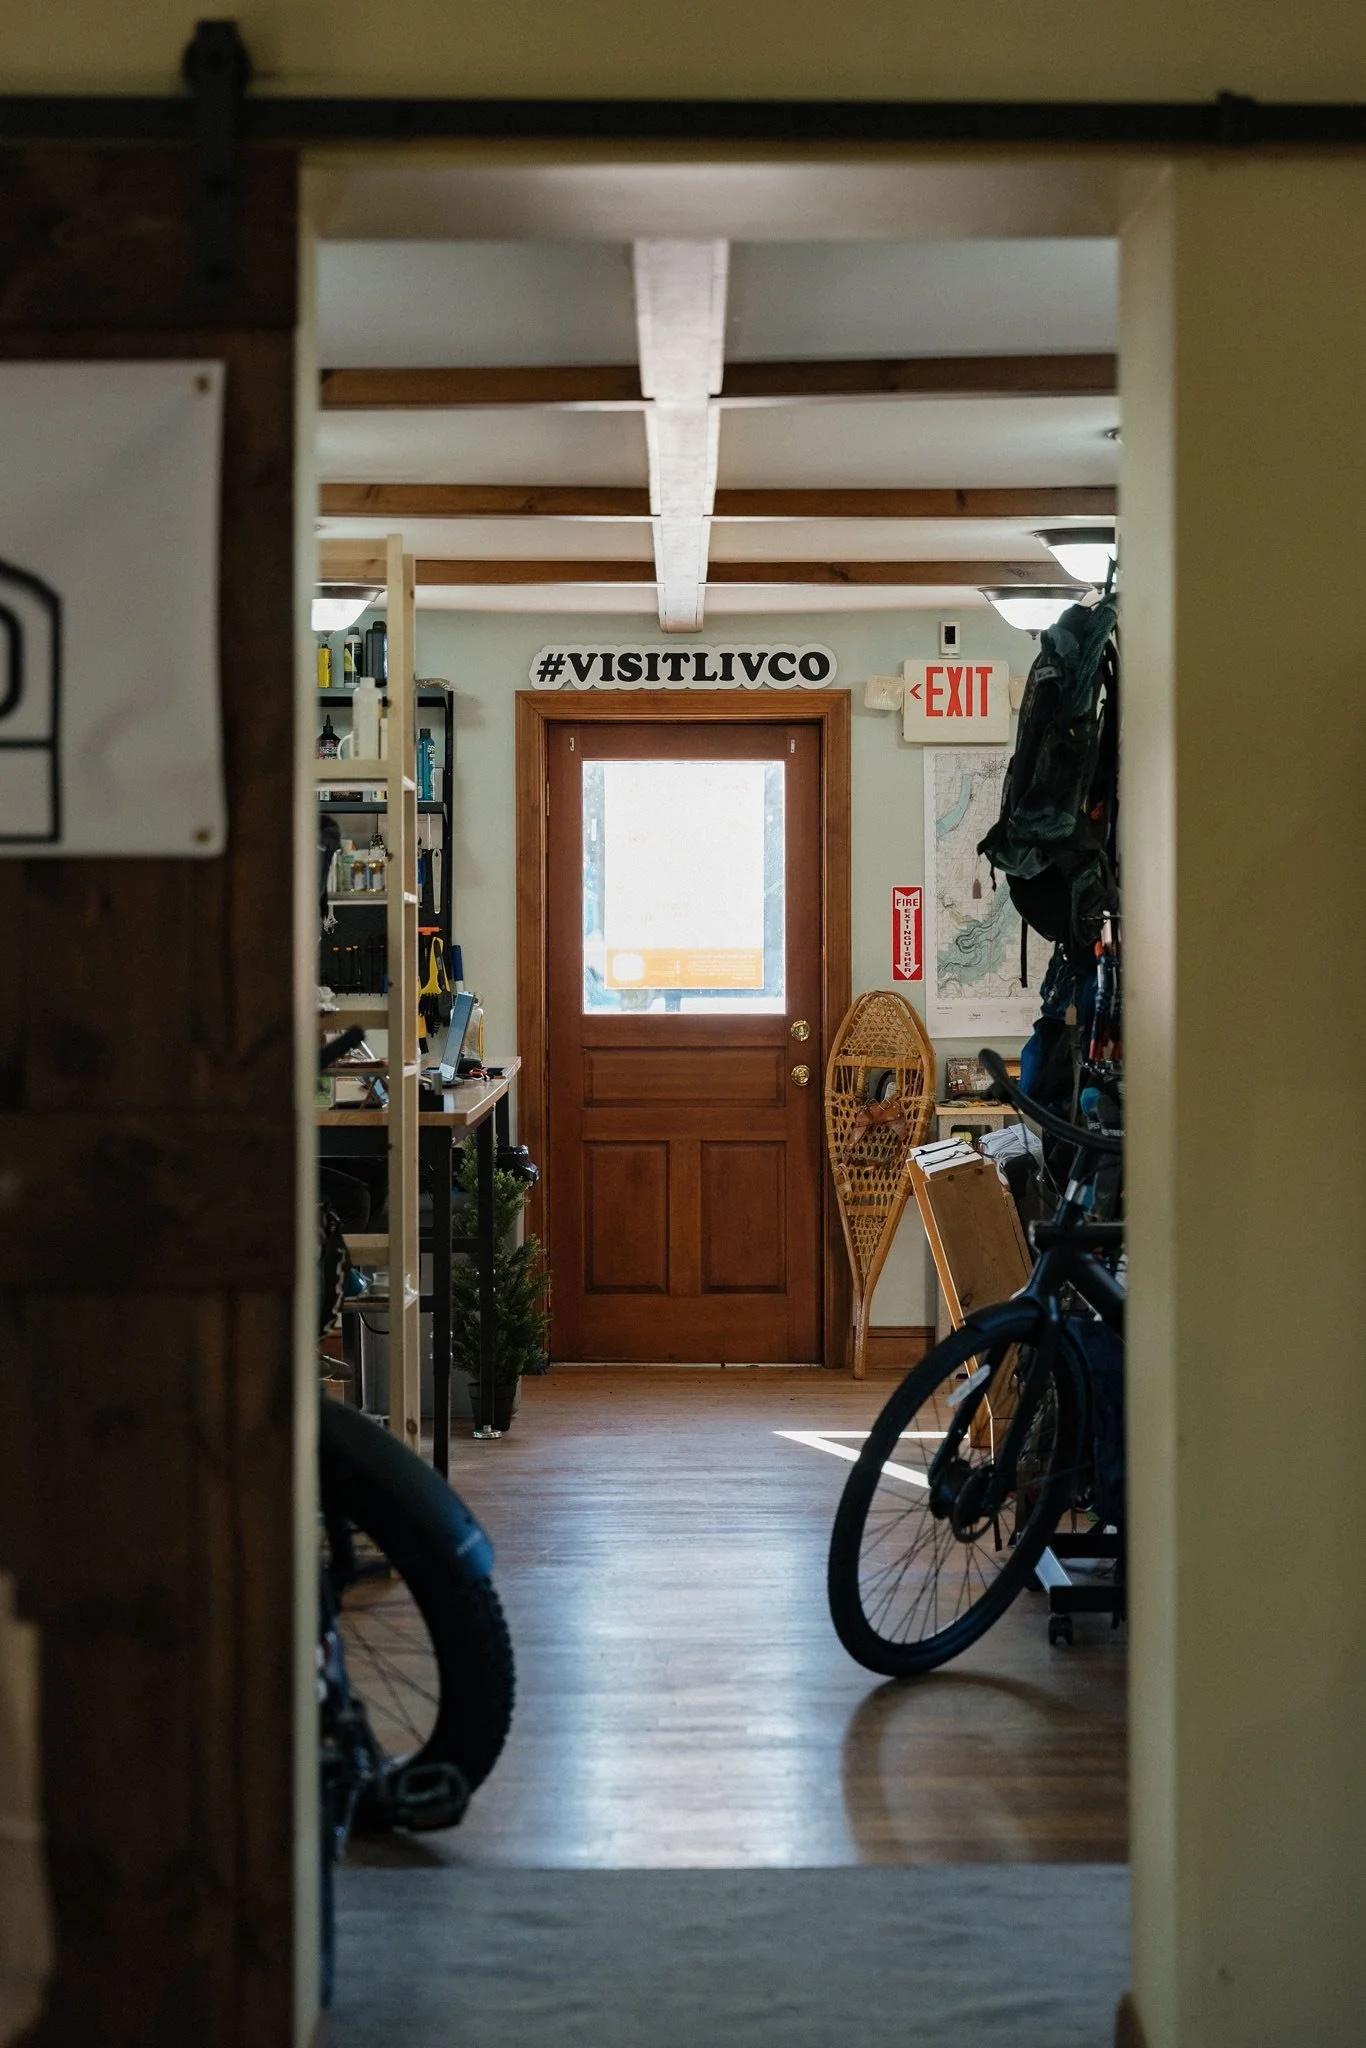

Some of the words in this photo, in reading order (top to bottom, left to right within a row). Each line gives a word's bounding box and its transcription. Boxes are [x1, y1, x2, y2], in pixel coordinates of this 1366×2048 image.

[536, 651, 830, 683] #VISITLIVCO
[926, 666, 993, 717] EXIT
[896, 898, 919, 907] FIRE
[903, 908, 912, 973] EXTINGUISHER
